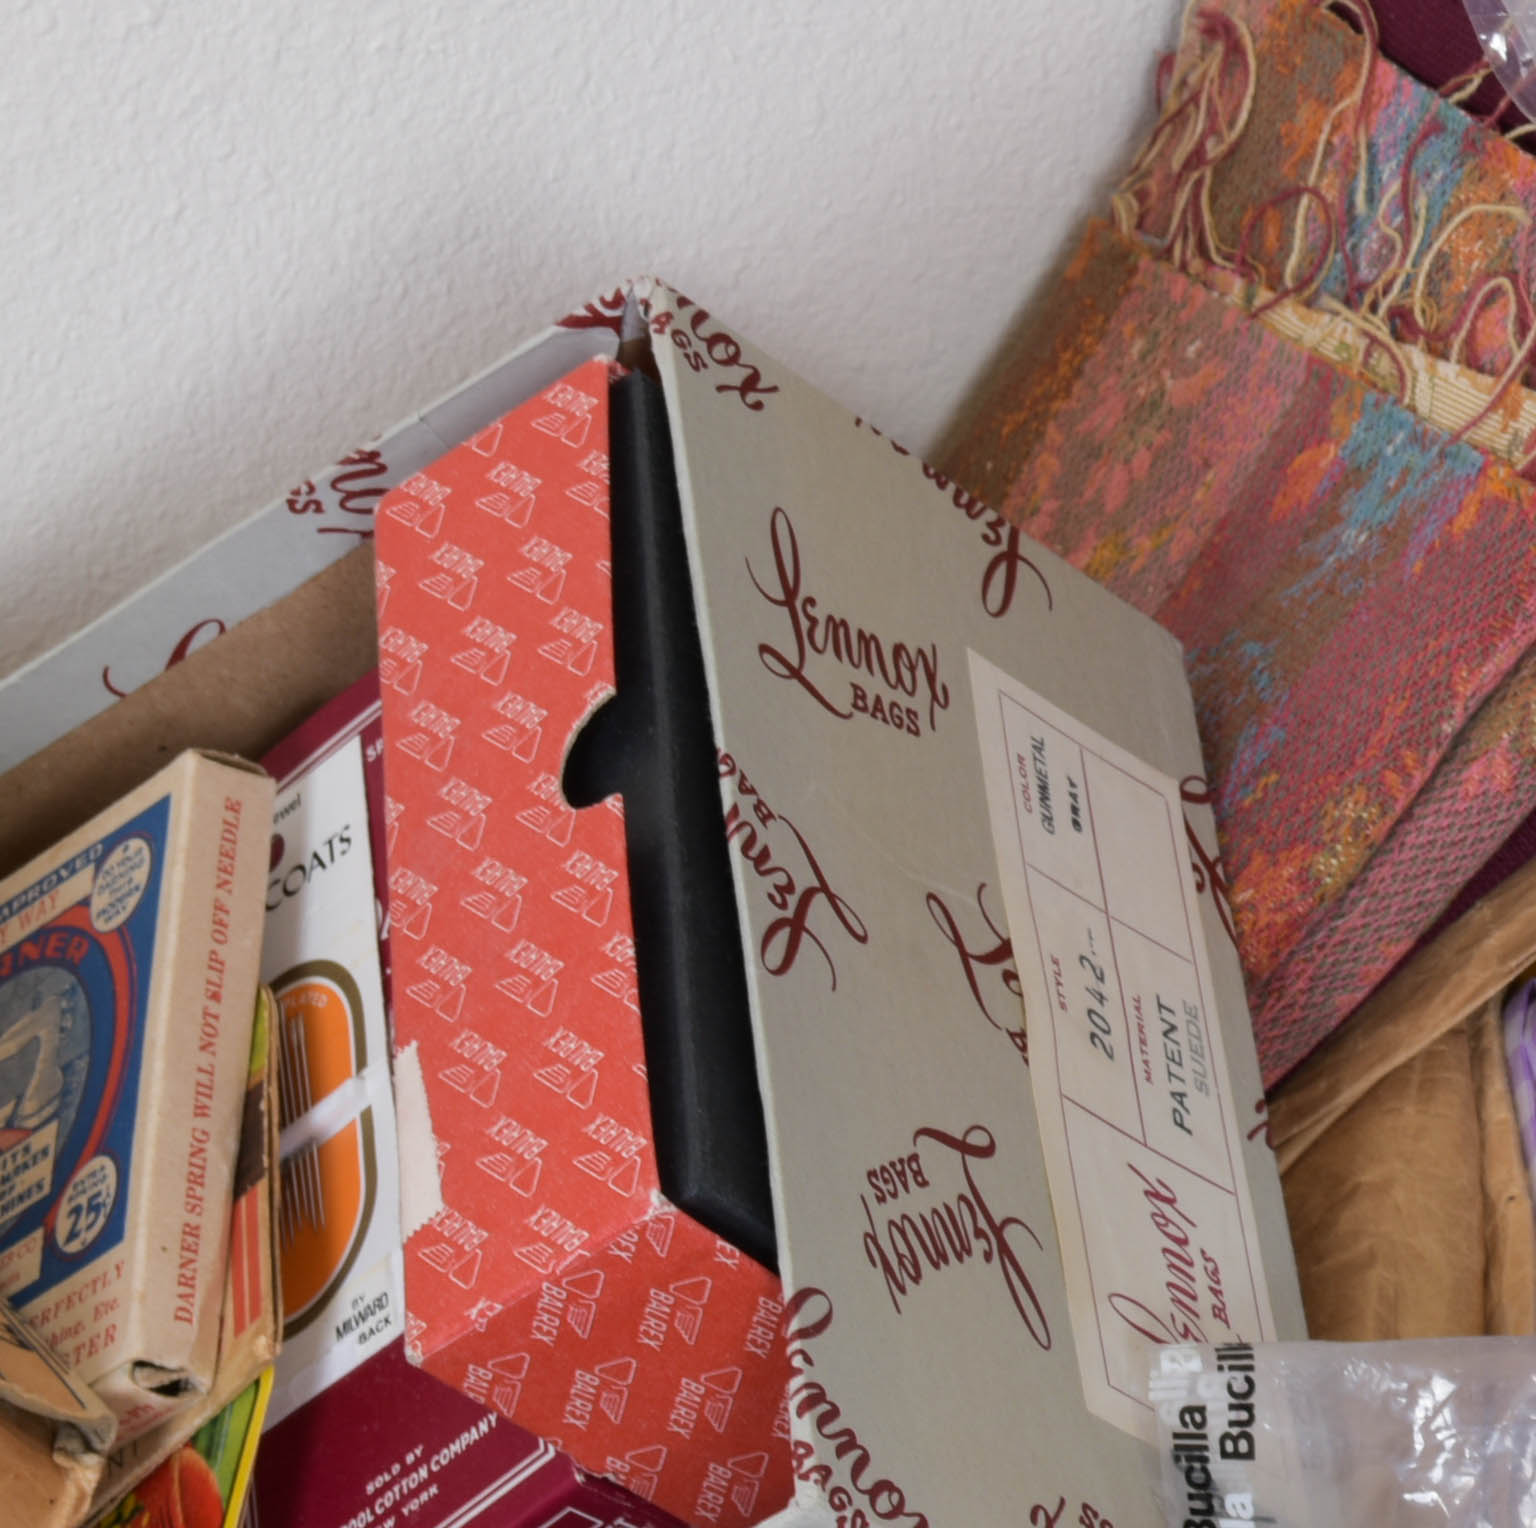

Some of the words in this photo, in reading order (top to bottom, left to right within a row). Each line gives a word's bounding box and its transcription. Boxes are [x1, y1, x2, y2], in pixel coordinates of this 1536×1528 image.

[849, 681, 921, 737] BAGS
[1017, 752, 1034, 815] COLOR
[1031, 735, 1056, 835] GUNMETAL
[217, 797, 243, 896] NEEDLE
[265, 823, 352, 912] COATS
[212, 898, 233, 955] OFF
[203, 951, 227, 1007] SLIP
[1052, 954, 1068, 1012] STYLE
[199, 1006, 221, 1059] NOT
[1136, 994, 1153, 1085] MATERIAL
[1182, 1000, 1210, 1097] SUEDE
[193, 1062, 216, 1121] WILL
[1156, 993, 1193, 1136] PATENT
[185, 1127, 210, 1217] SPRING
[867, 1152, 930, 1206] BAGS
[174, 1222, 200, 1326] DARNER
[351, 1293, 365, 1311] BY
[1200, 1247, 1231, 1329] BAGS
[335, 1291, 389, 1343] MILWARD
[358, 1316, 392, 1345] BACK
[531, 1281, 567, 1347] BALREX
[638, 1288, 674, 1352] BALREX
[745, 1296, 783, 1359] BALREX
[563, 1370, 599, 1432] BALREX
[667, 1377, 704, 1440] BALREX
[365, 1462, 402, 1496] SOLD
[405, 1443, 424, 1465] BY
[375, 1463, 429, 1516] COTTON
[430, 1412, 499, 1472] COMPANY
[694, 1463, 731, 1522] BALREX
[401, 1484, 439, 1518] YORK
